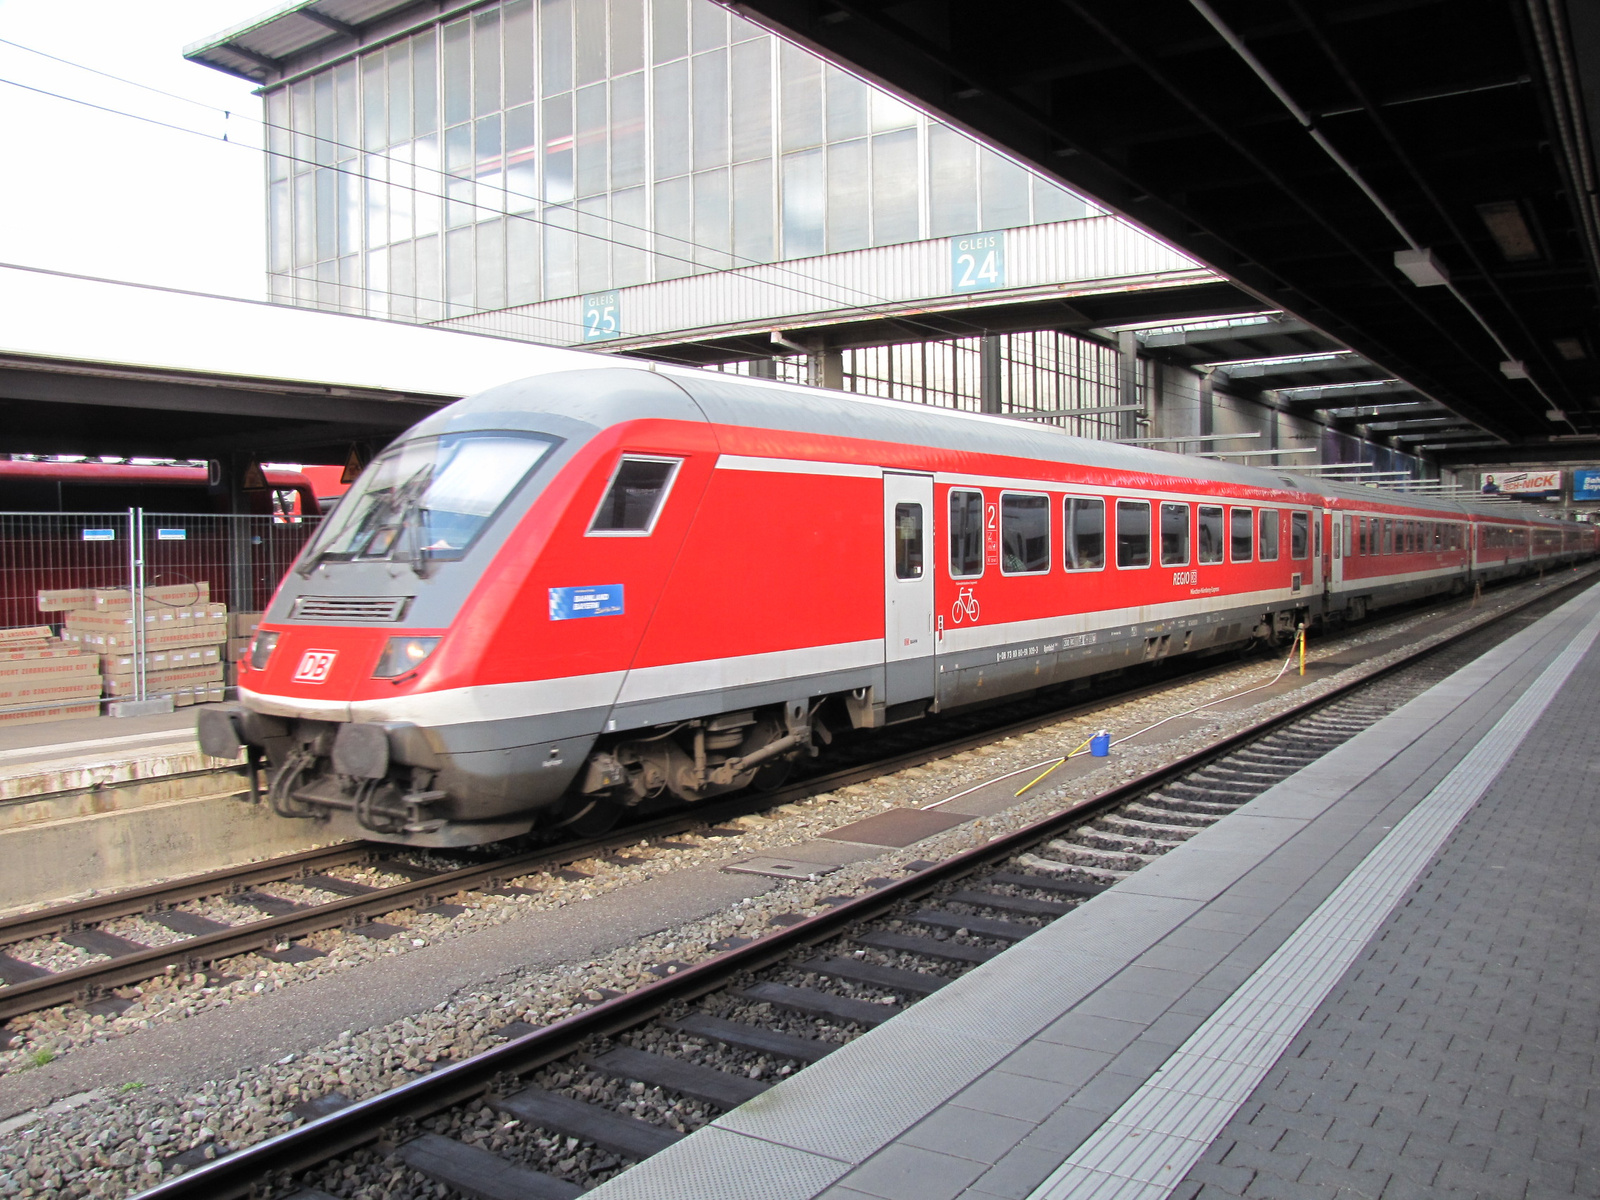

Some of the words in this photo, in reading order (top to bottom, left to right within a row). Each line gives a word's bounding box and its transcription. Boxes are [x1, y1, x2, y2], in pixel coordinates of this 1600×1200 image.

[958, 236, 995, 251] GLEIS
[957, 250, 999, 287] 24
[588, 294, 614, 307] GLEIS
[587, 306, 616, 337] 25
[988, 505, 996, 529] 2
[1282, 518, 1288, 533] 2
[1173, 572, 1190, 585] REGIO
[298, 652, 332, 680] DB
